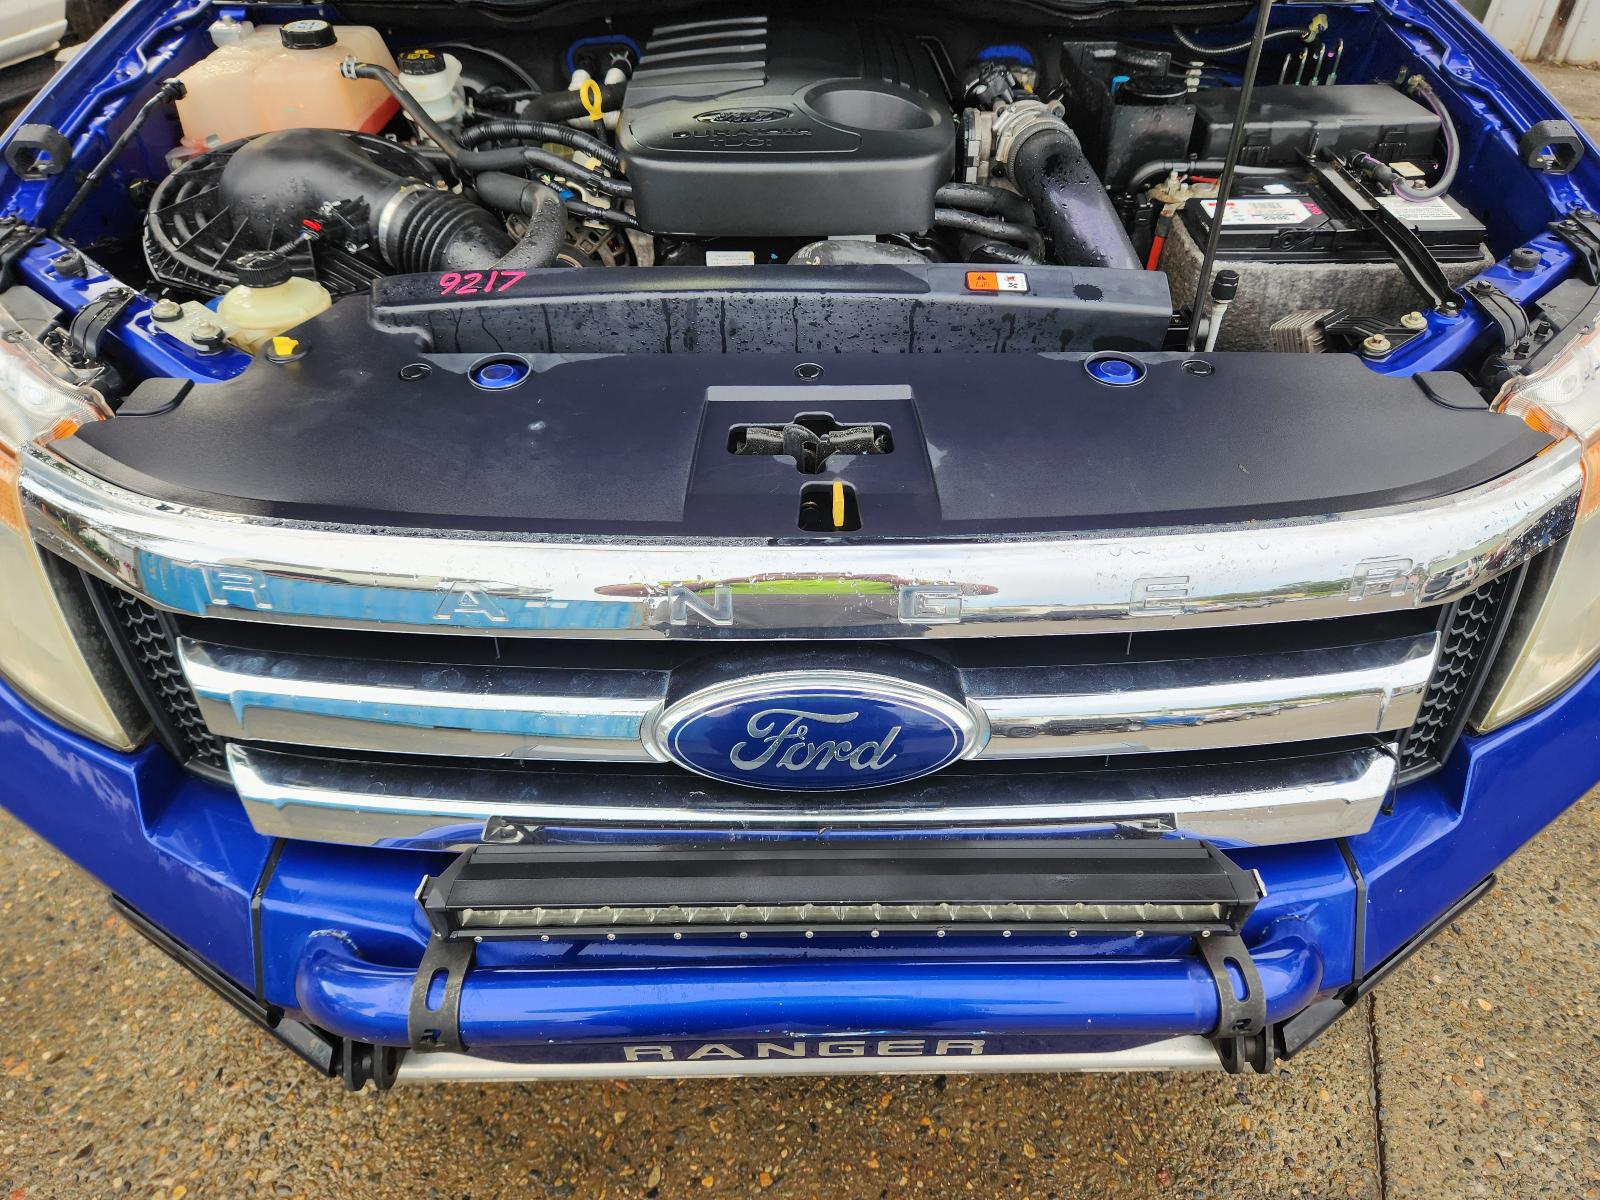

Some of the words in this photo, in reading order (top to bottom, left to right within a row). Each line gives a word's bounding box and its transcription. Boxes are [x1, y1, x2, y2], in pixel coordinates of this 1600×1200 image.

[439, 270, 527, 295] 9217
[201, 555, 1413, 625] RANGER
[729, 708, 902, 770] Ford
[623, 1039, 985, 1062] RANGER
